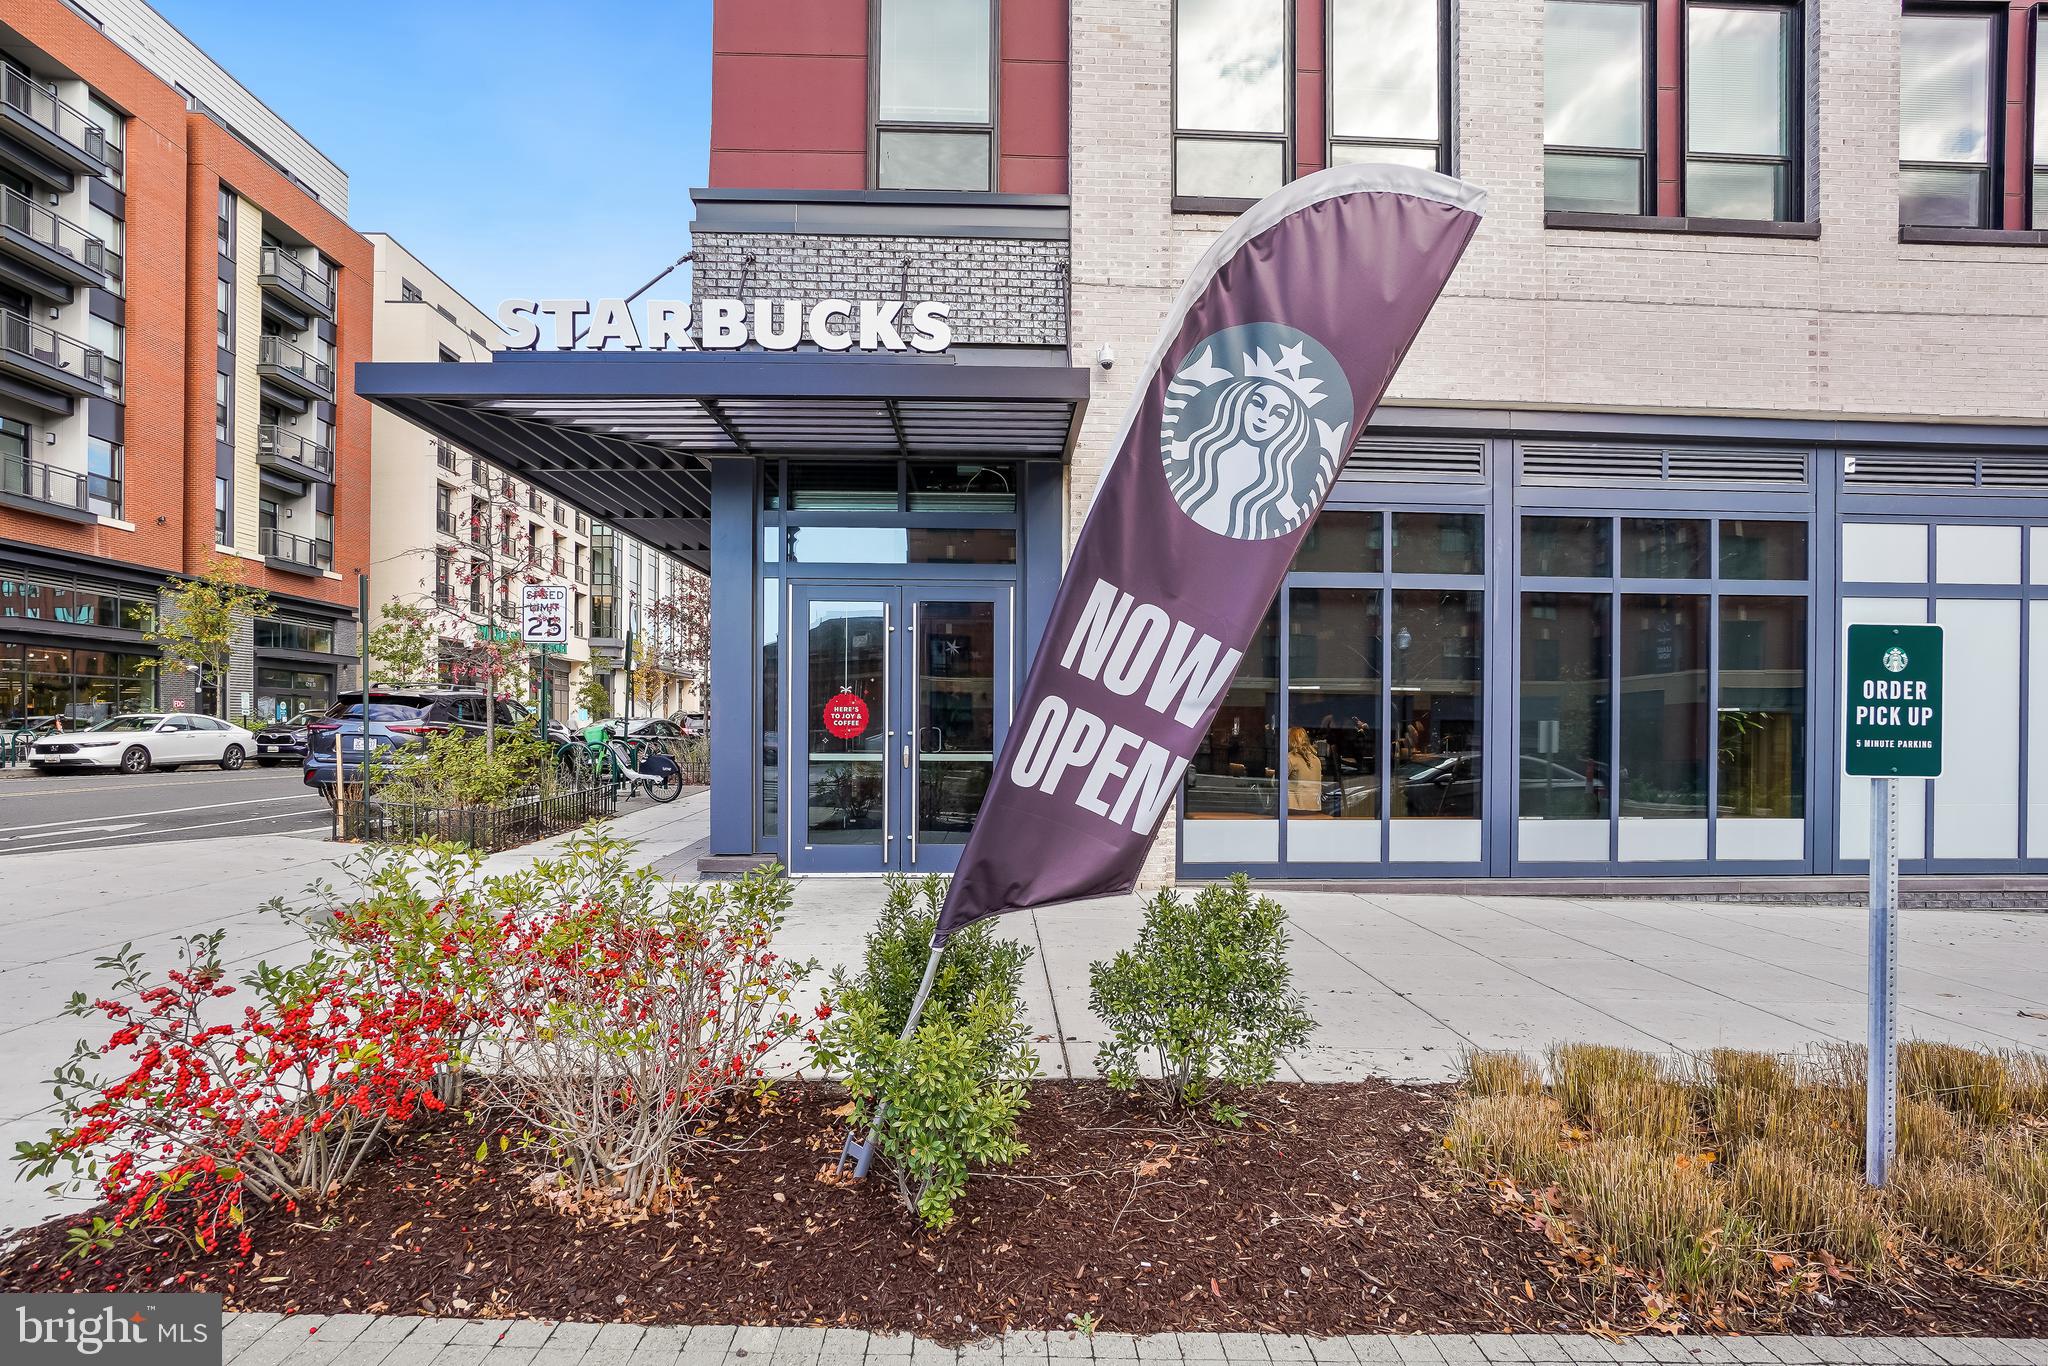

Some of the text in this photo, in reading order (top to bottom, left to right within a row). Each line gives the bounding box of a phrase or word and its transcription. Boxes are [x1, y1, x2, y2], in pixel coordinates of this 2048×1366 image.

[497, 298, 953, 352] STARBUCKS
[527, 615, 562, 637] 25
[1060, 577, 1243, 729] NOW
[1863, 679, 1927, 700] ORDER
[173, 700, 185, 708] FDC
[1855, 705, 1933, 726] PICK UP
[1855, 739, 1933, 749] 5 MINUTE PARKING
[1010, 695, 1190, 836] OPEN
